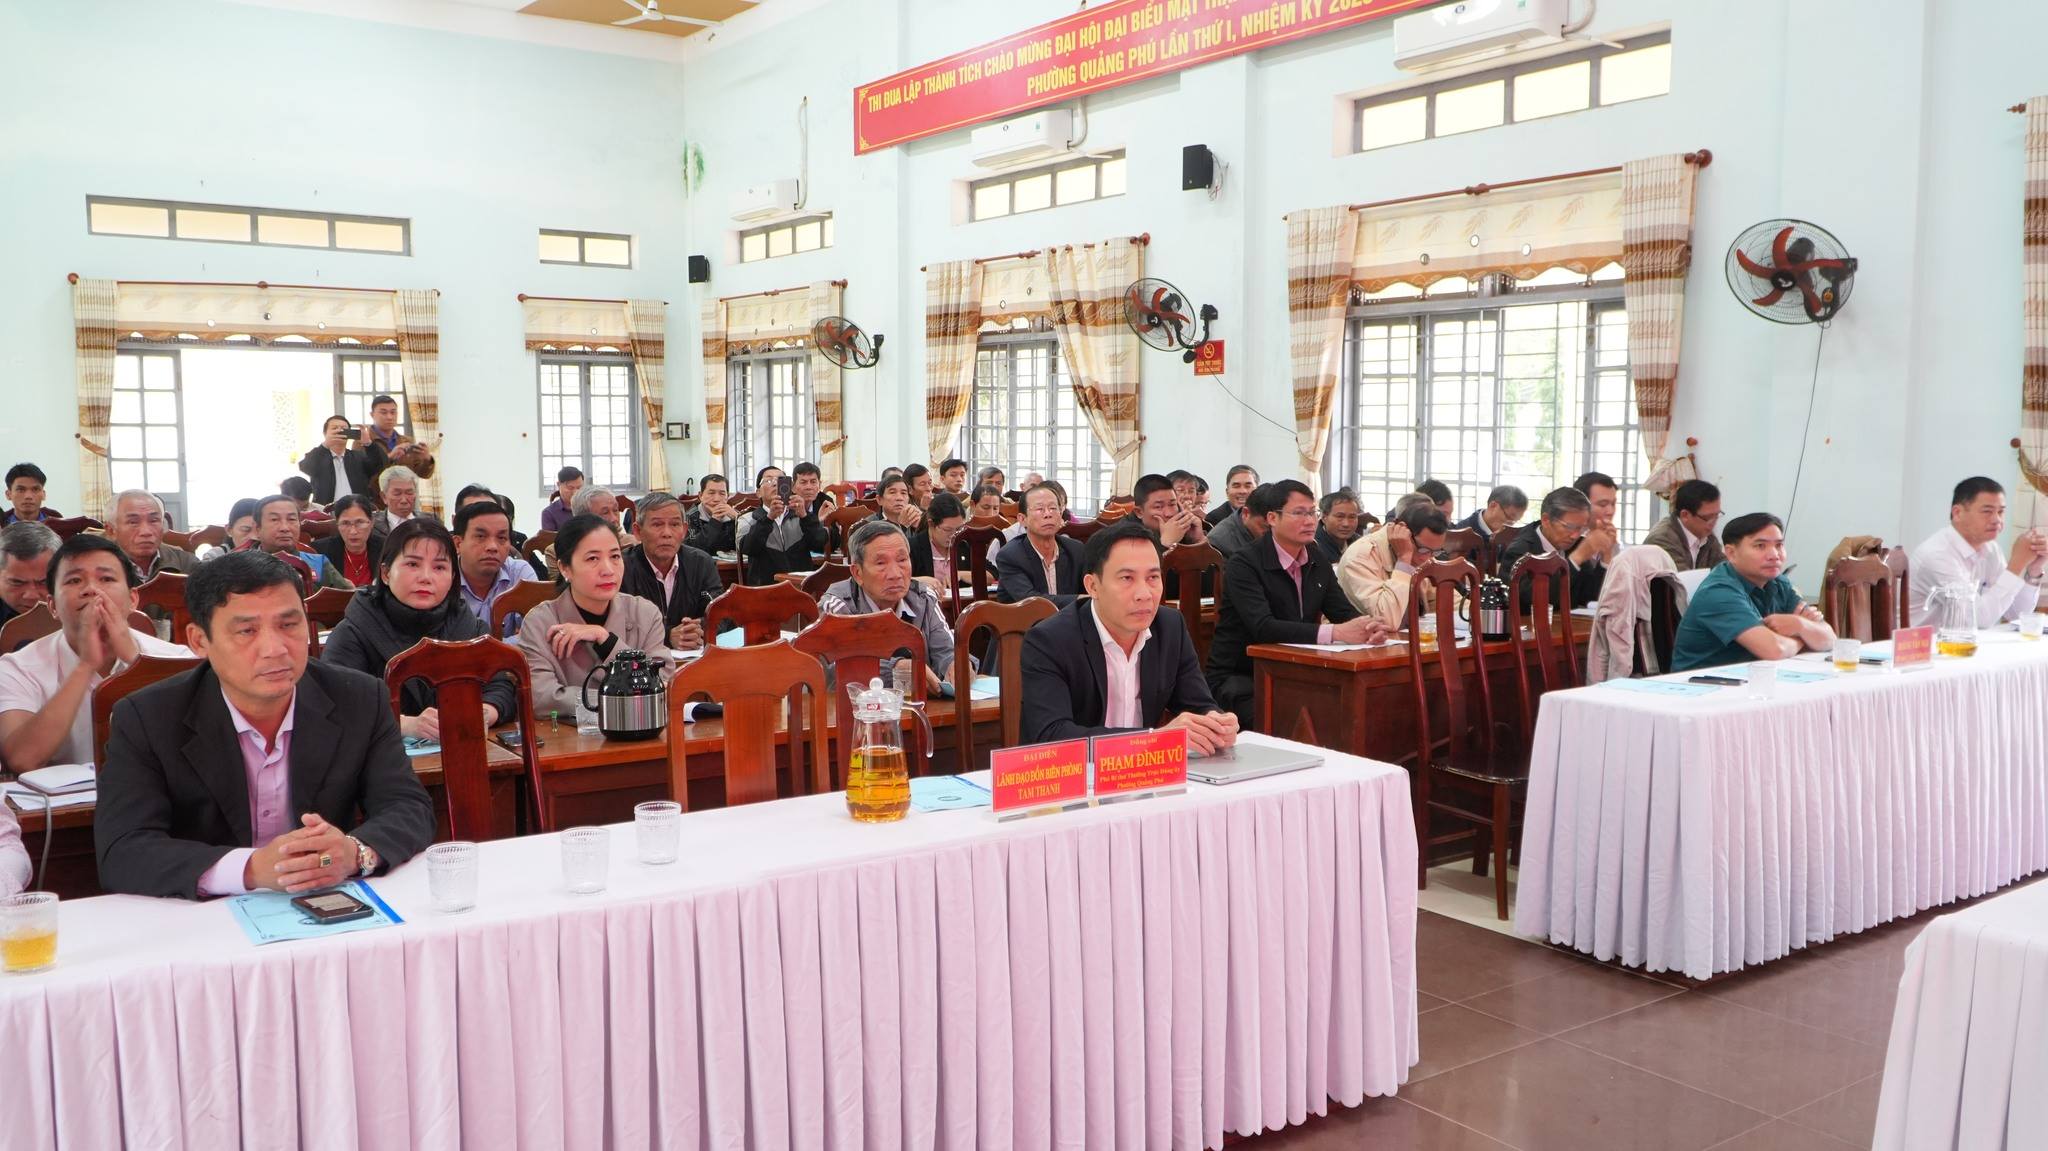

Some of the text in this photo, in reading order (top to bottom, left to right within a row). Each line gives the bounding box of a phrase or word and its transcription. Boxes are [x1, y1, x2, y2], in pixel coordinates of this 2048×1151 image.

[867, 92, 882, 113] THI
[884, 87, 902, 108] ĐUA
[904, 79, 921, 104] LẬP
[923, 70, 956, 96] THÀNH
[959, 61, 982, 86] TÍCH
[984, 50, 1014, 77] CHÀO
[1017, 40, 1052, 68] MỪNG
[1055, 31, 1076, 56] ĐẠI
[1079, 21, 1101, 49] HỘI
[1104, 15, 1127, 42] ĐẠI
[1131, 2, 1164, 33] BIỂU
[1027, 65, 1076, 97] PHƯỜNG
[1079, 50, 1124, 83] QUẢNG
[1128, 37, 1156, 69] PHÚ
[1160, 28, 1189, 60] LẦN
[1193, 18, 1224, 50] THỨ
[1226, 19, 1237, 43] I,
[1241, 2, 1296, 38] NHIỆM
[1015, 771, 1030, 785] ĐẠO
[1045, 764, 1060, 780] BIÊN
[1061, 761, 1083, 778] PHÒNG
[1100, 745, 1184, 773] PHẠM ĐÌNH VŨ
[1018, 782, 1061, 800] TAM THANH
